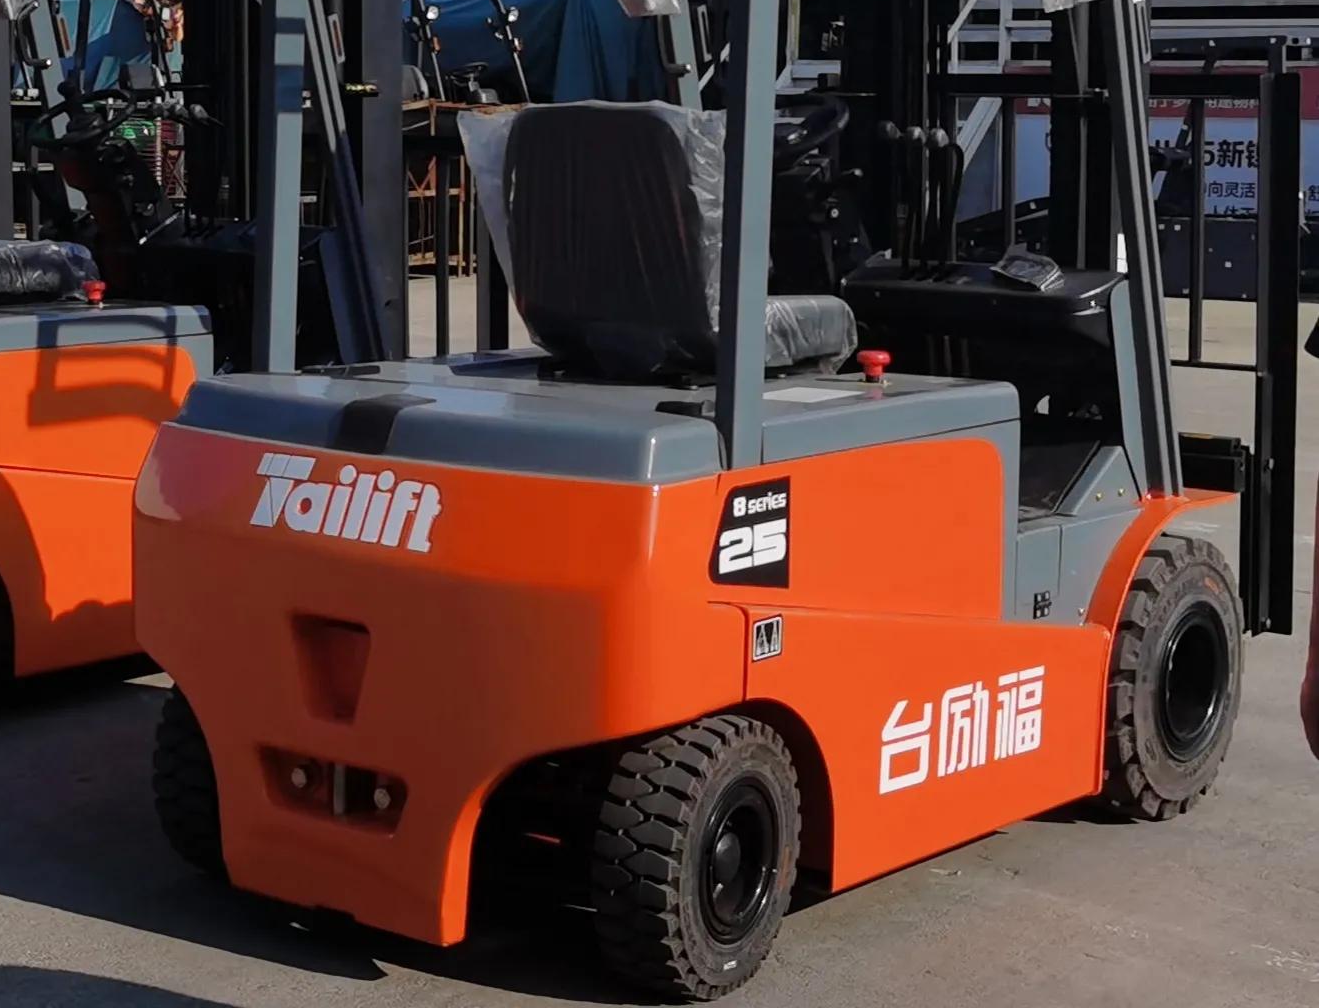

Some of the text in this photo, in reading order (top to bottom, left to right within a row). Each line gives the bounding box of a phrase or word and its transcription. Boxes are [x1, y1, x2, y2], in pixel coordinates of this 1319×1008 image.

[249, 452, 442, 553] Tailift
[733, 491, 788, 518] 8 series
[718, 518, 788, 575] 25
[879, 665, 1046, 796] 台励福
